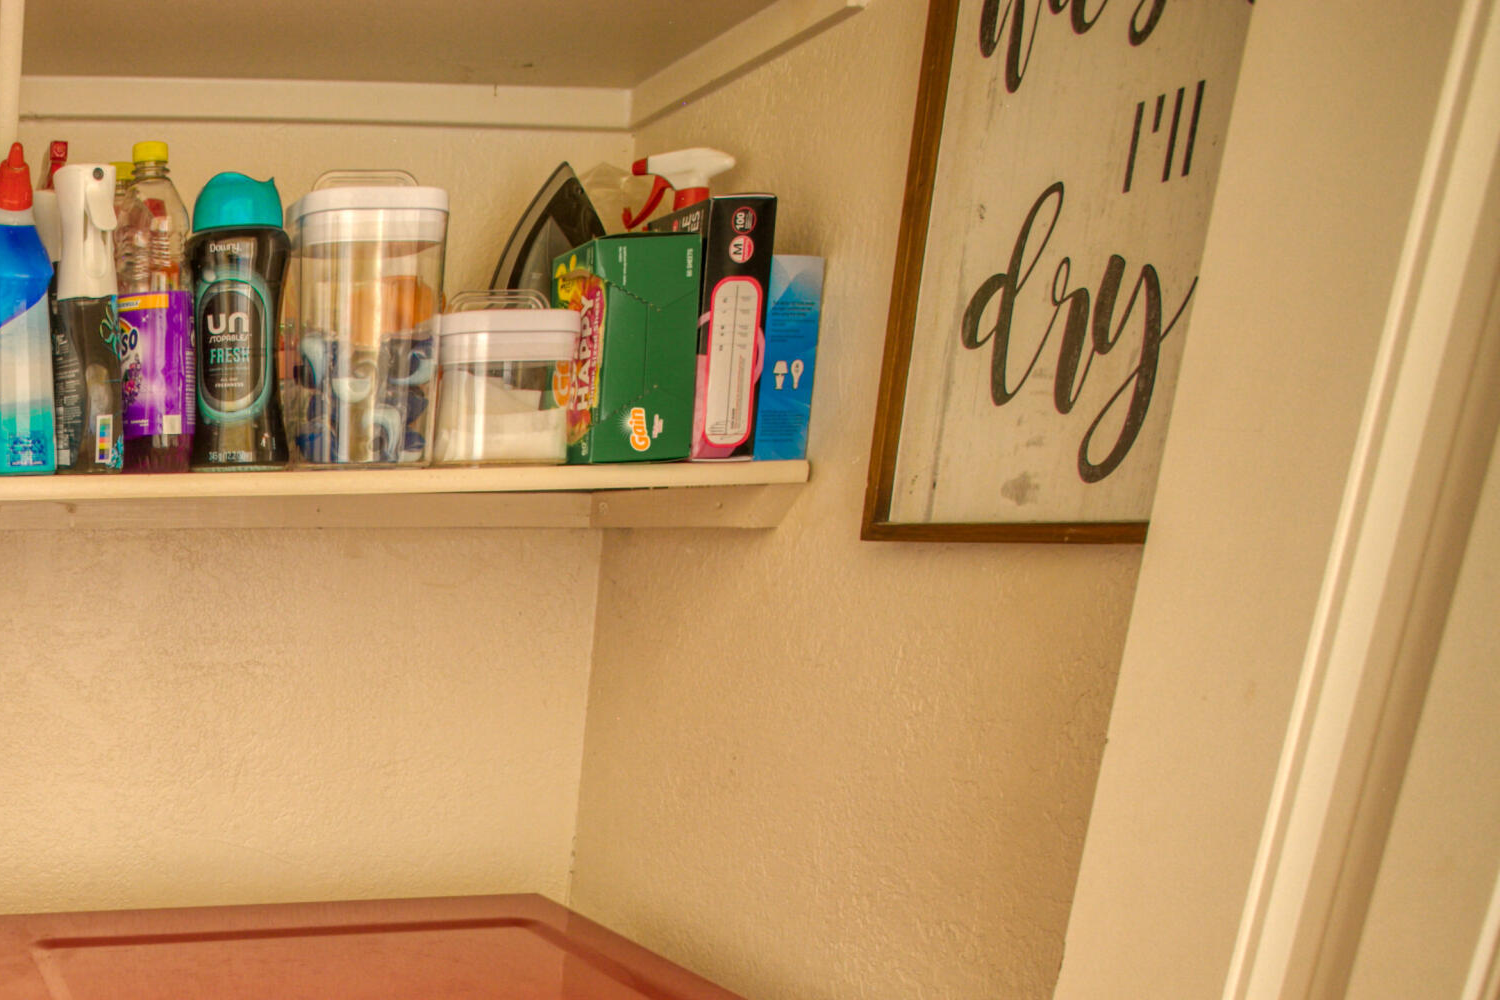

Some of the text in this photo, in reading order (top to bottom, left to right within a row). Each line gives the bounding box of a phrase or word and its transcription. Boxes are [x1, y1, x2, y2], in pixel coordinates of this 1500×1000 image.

[1122, 80, 1206, 193] I'll
[735, 212, 746, 231] 100
[209, 242, 240, 254] Downy
[732, 242, 743, 256] M
[961, 181, 1199, 484] dry
[209, 346, 250, 365] FRESH
[576, 295, 594, 411] HAPPY
[630, 407, 650, 451] Gain
